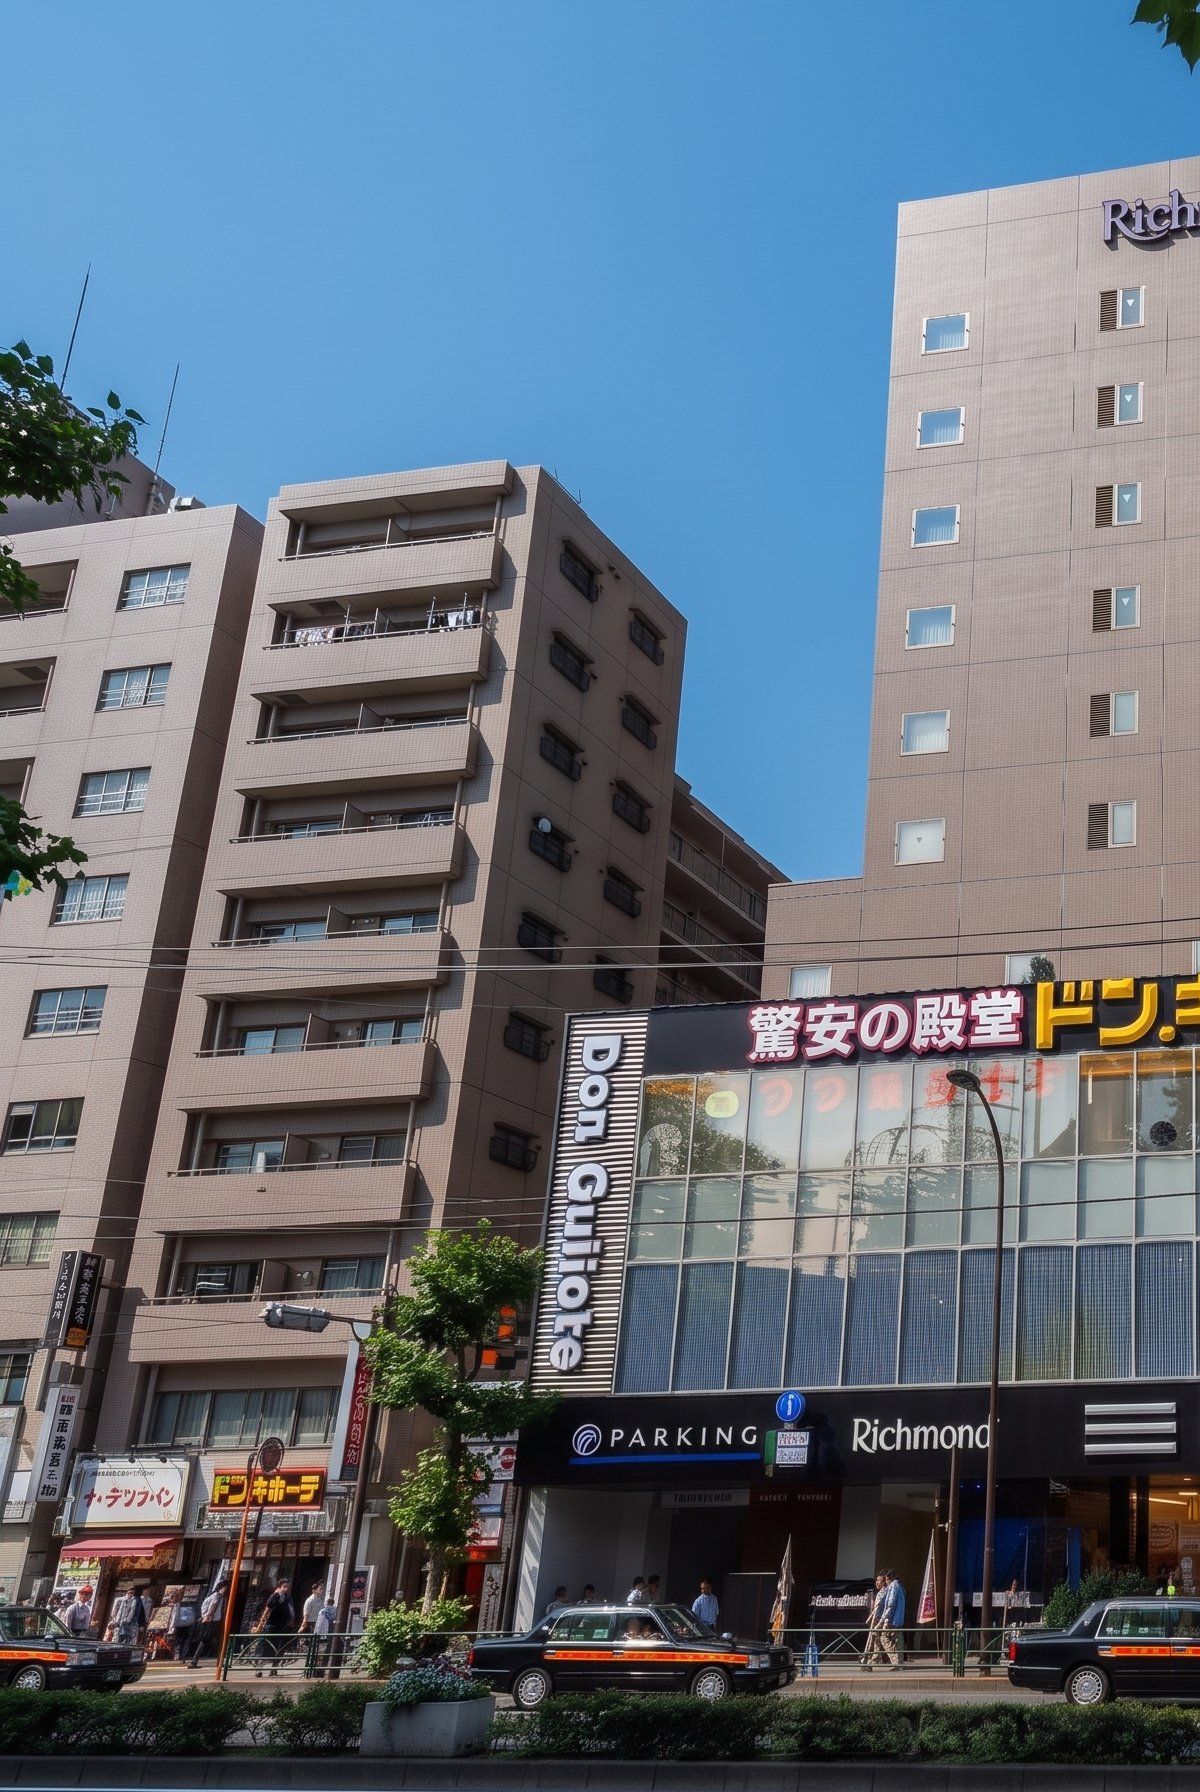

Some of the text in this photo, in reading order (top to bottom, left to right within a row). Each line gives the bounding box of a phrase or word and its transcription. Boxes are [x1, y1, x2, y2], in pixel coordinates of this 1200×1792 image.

[748, 987, 1025, 1062] 驚安の殿堂
[574, 1034, 623, 1143] Don
[610, 1425, 758, 1448] PARKING
[852, 1413, 991, 1454] Richmond
